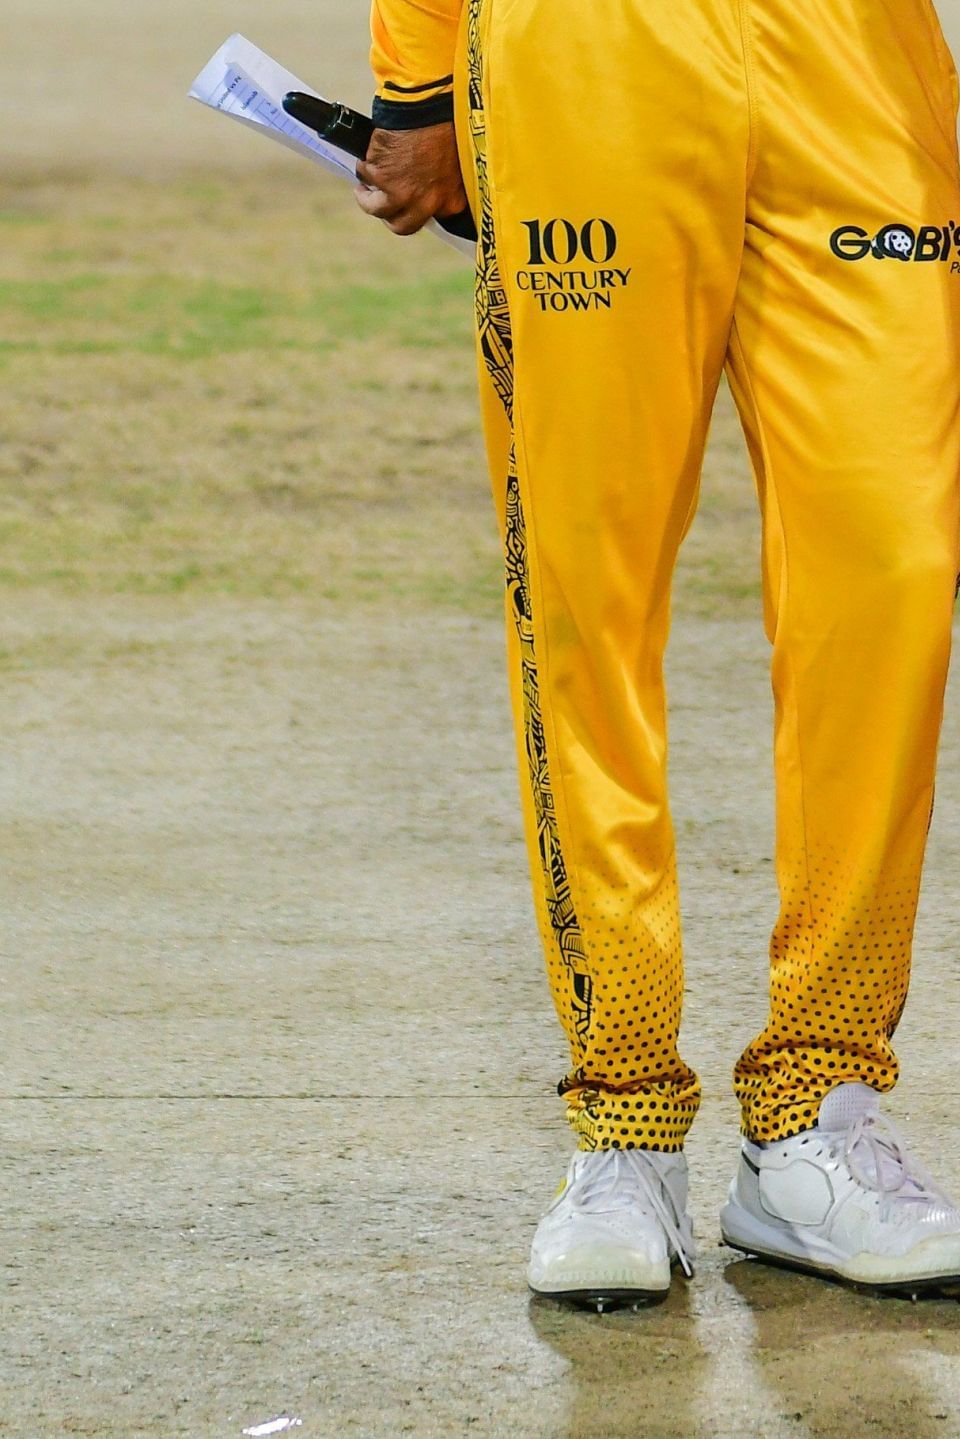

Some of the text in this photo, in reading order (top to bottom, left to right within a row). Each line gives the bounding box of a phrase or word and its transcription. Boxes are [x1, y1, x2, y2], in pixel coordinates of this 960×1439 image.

[520, 218, 617, 265] 100
[516, 267, 631, 291] CENTURY
[534, 291, 611, 312] TOWN
